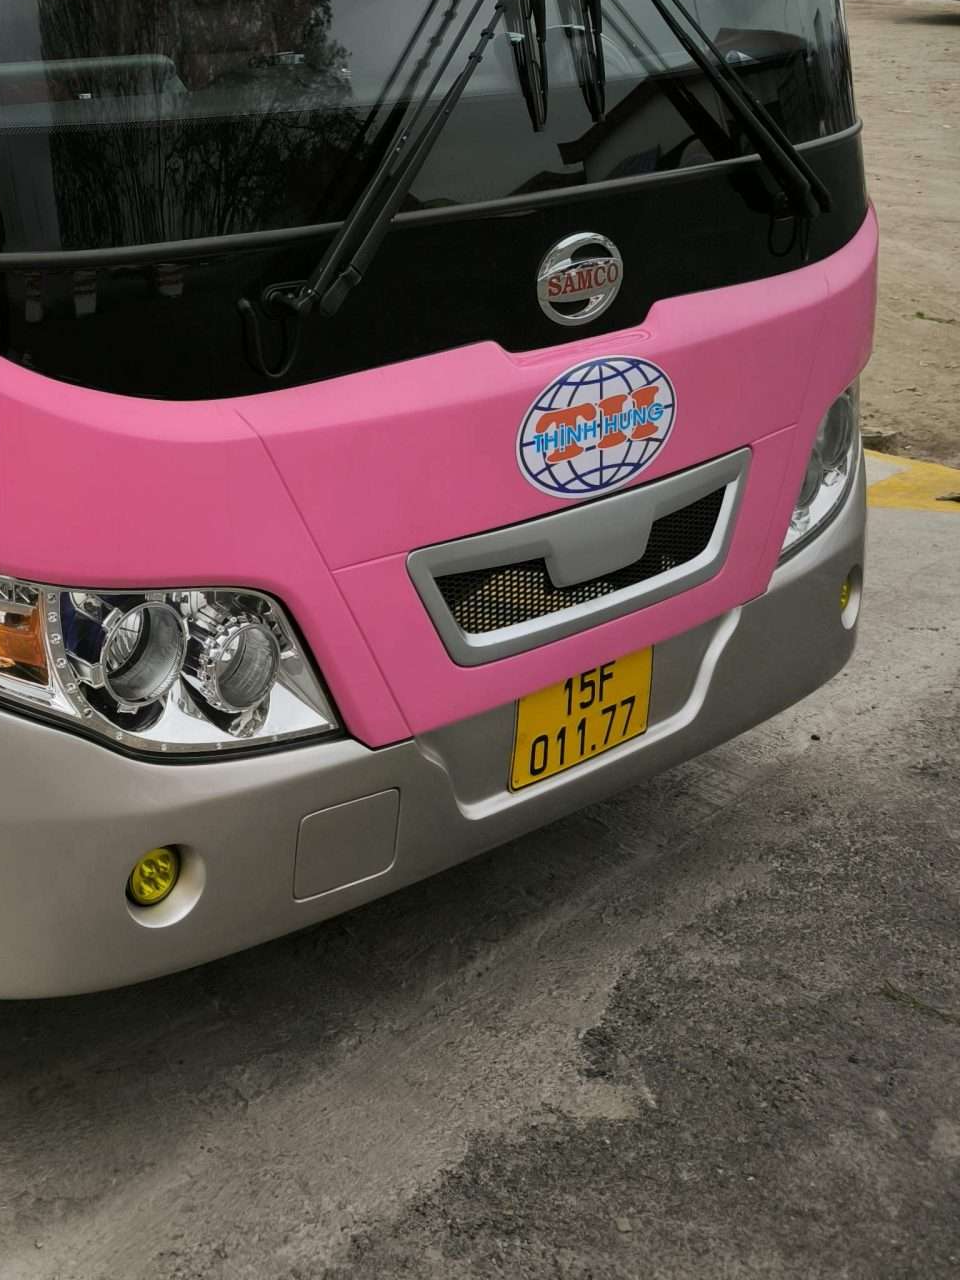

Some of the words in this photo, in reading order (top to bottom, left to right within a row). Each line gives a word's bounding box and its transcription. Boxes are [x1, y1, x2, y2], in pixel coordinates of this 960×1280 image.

[547, 262, 620, 297] SAMCO
[563, 660, 617, 716] 15F
[529, 695, 637, 776] 011.77
